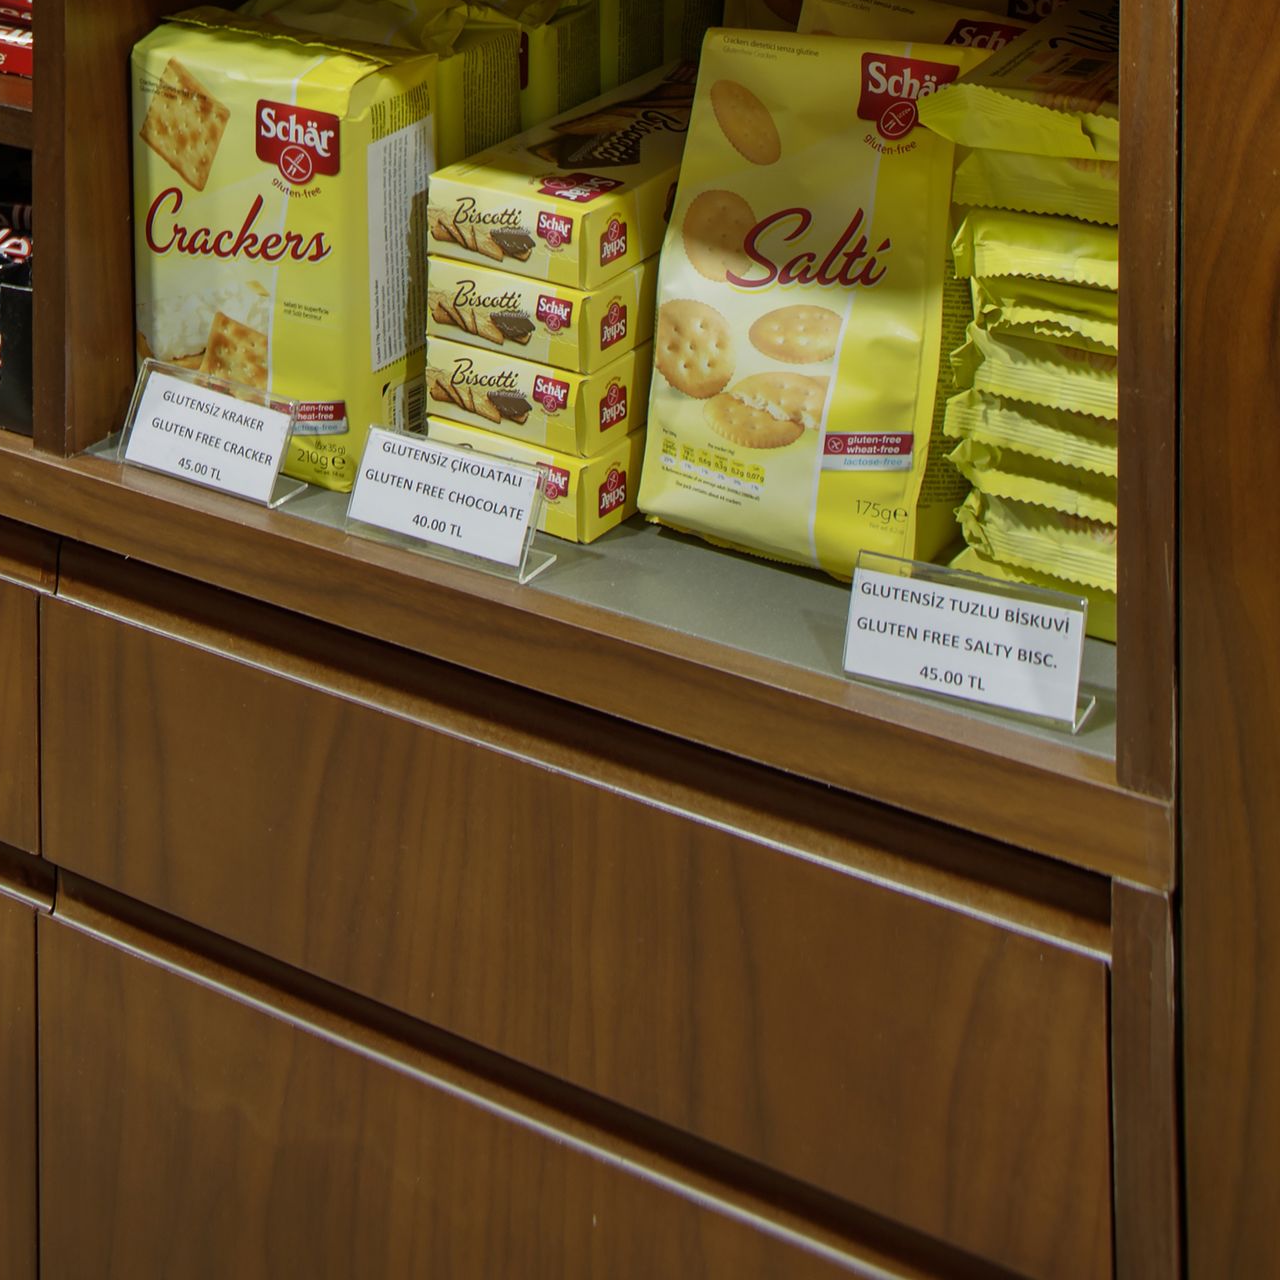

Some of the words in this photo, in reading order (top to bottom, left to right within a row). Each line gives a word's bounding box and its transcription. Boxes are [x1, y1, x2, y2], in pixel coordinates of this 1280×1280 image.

[260, 107, 335, 157] Schär
[863, 133, 918, 156] gluten-free
[270, 177, 323, 199] gluten-free
[453, 196, 521, 226] Biscotti
[145, 187, 333, 262] Crackers
[538, 214, 572, 235] Schär
[453, 279, 521, 309] Biscotti
[538, 298, 571, 320] Schär
[451, 358, 520, 389] Biscotti
[534, 379, 569, 401] Schär
[162, 388, 221, 420] GLUTENSİZ
[223, 405, 264, 432] KRAKER
[151, 416, 194, 441] GLUTEN
[196, 430, 223, 450] FREE
[223, 436, 273, 466] CRACKER
[846, 434, 902, 445] gluten-free
[846, 444, 900, 456] wheat-free
[177, 456, 206, 477] 45.00
[208, 467, 222, 482] TL
[297, 449, 328, 470] 210g
[382, 441, 448, 469] GLUTENSİZ
[450, 457, 522, 488] ÇİKOLATALI
[843, 456, 904, 468] lactose-free
[365, 468, 414, 495] GLUTEN
[416, 483, 445, 503] FREE
[449, 488, 525, 522] CHOCOLATE
[854, 498, 894, 525] 175g
[412, 513, 447, 534] 40.00
[449, 523, 463, 539] TL
[861, 581, 945, 610] GLUTENSİZ
[950, 598, 1000, 620] TUZLU
[1005, 608, 1070, 634] BİSKUVİ
[856, 616, 918, 641] GLUTEN
[922, 630, 959, 648] FREE
[964, 638, 1012, 658] SALTY
[1018, 649, 1057, 669] BISC.
[920, 666, 963, 686] 45.00
[968, 675, 986, 691] TL
